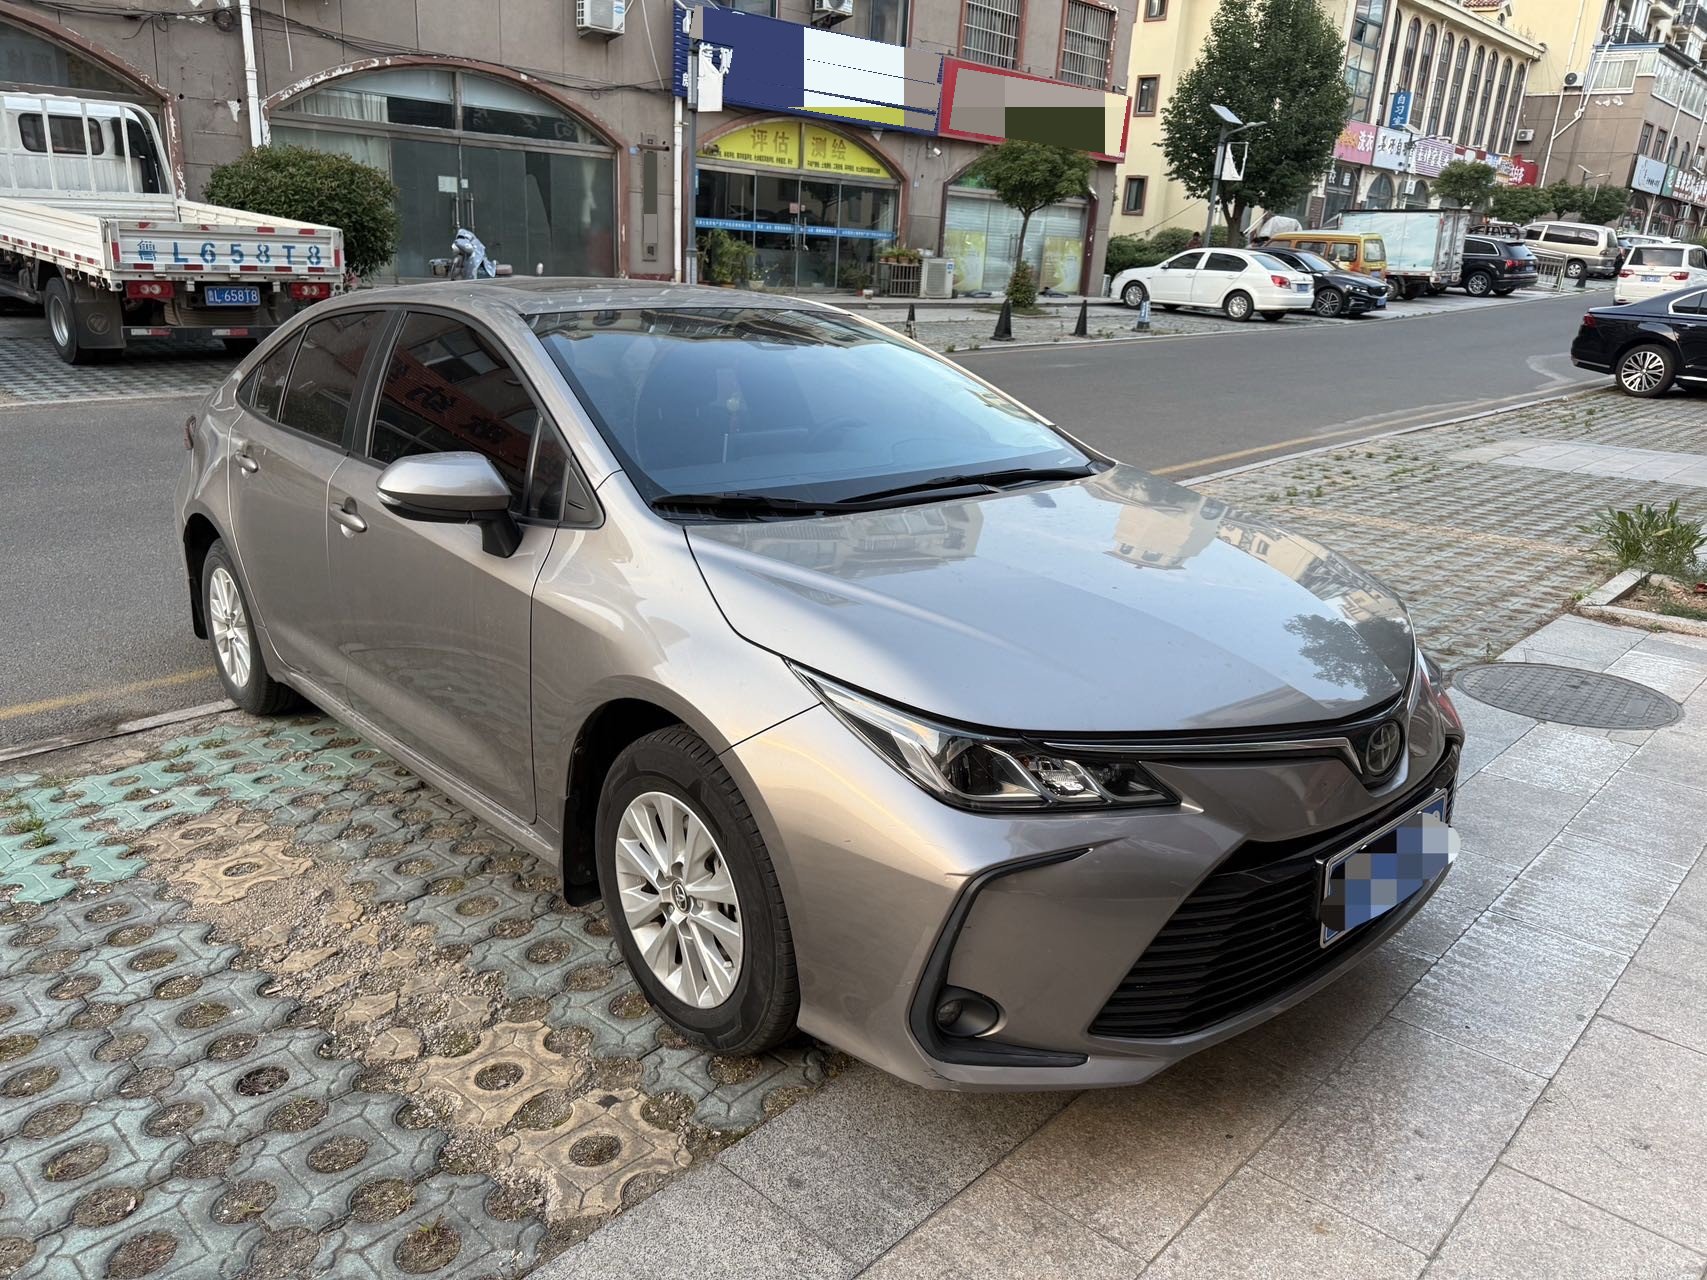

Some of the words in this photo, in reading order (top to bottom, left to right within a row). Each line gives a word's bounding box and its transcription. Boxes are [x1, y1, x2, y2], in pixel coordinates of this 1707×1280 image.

[1392, 95, 1406, 126] 自习室
[750, 128, 790, 155] 评估
[812, 137, 847, 160] 测绘
